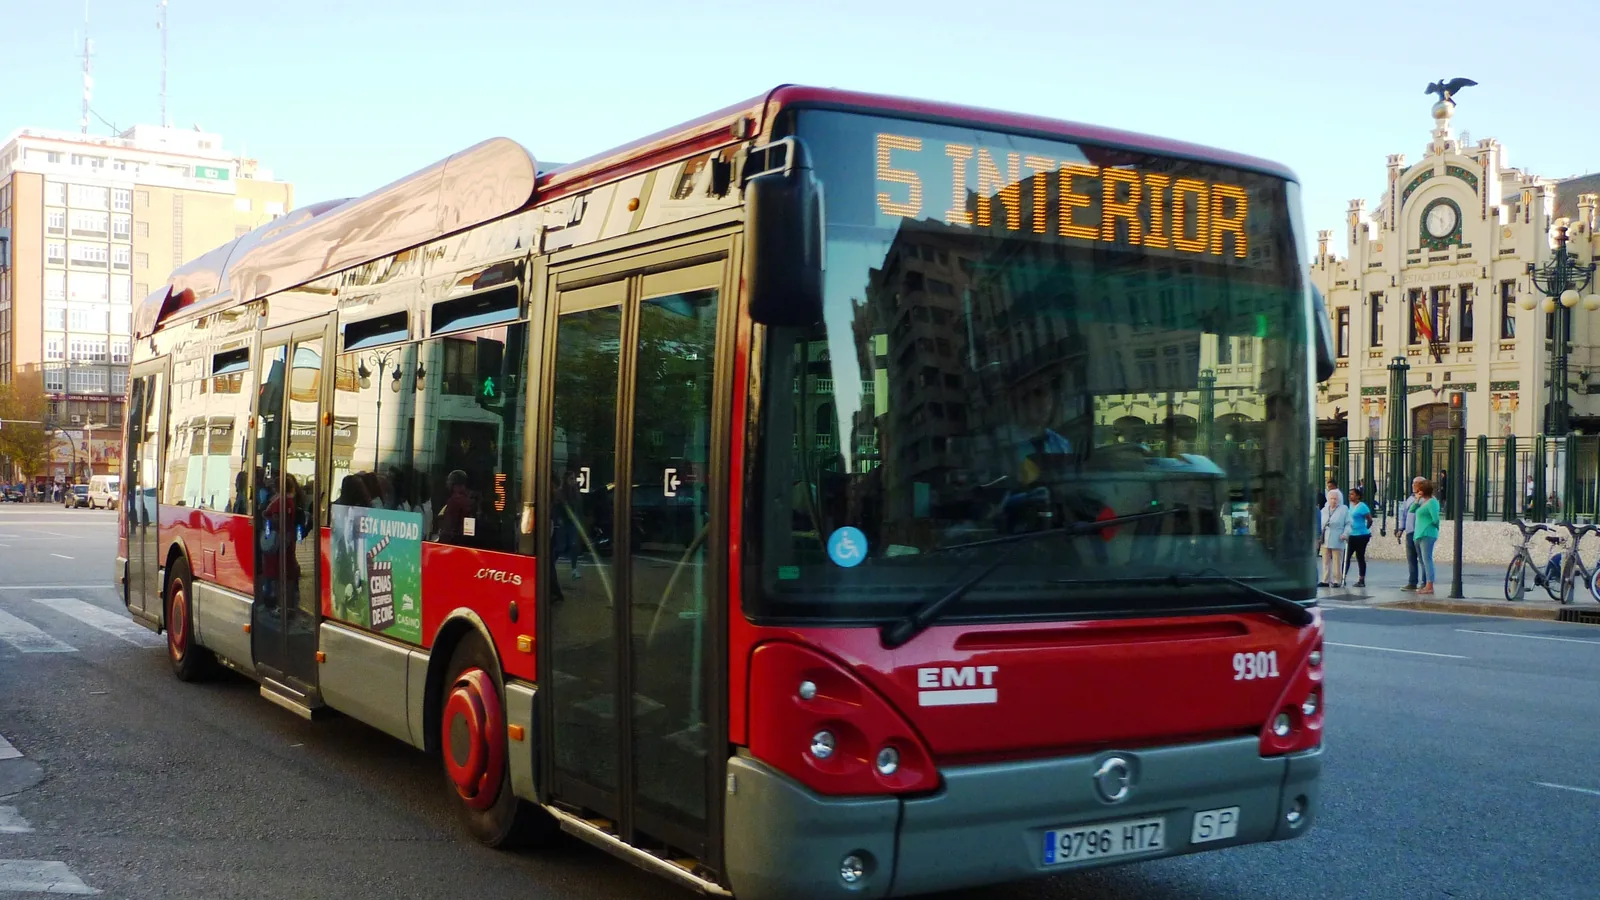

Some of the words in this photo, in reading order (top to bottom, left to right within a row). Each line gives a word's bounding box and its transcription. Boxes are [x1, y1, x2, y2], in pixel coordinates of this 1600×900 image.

[876, 133, 923, 217] 5
[944, 144, 1248, 258] INTERIOR
[494, 473, 507, 511] 5
[360, 516, 379, 534] ESTA
[380, 519, 418, 540] NAVIDAD
[370, 575, 392, 594] CENAS
[372, 608, 381, 626] DE
[381, 605, 394, 623] CINE
[397, 613, 420, 629] CASINO
[918, 665, 998, 688] EMT
[1232, 650, 1280, 680] 9301
[1199, 811, 1232, 838] SP
[1060, 829, 1111, 858] 9796
[1123, 822, 1160, 850] HTZ
